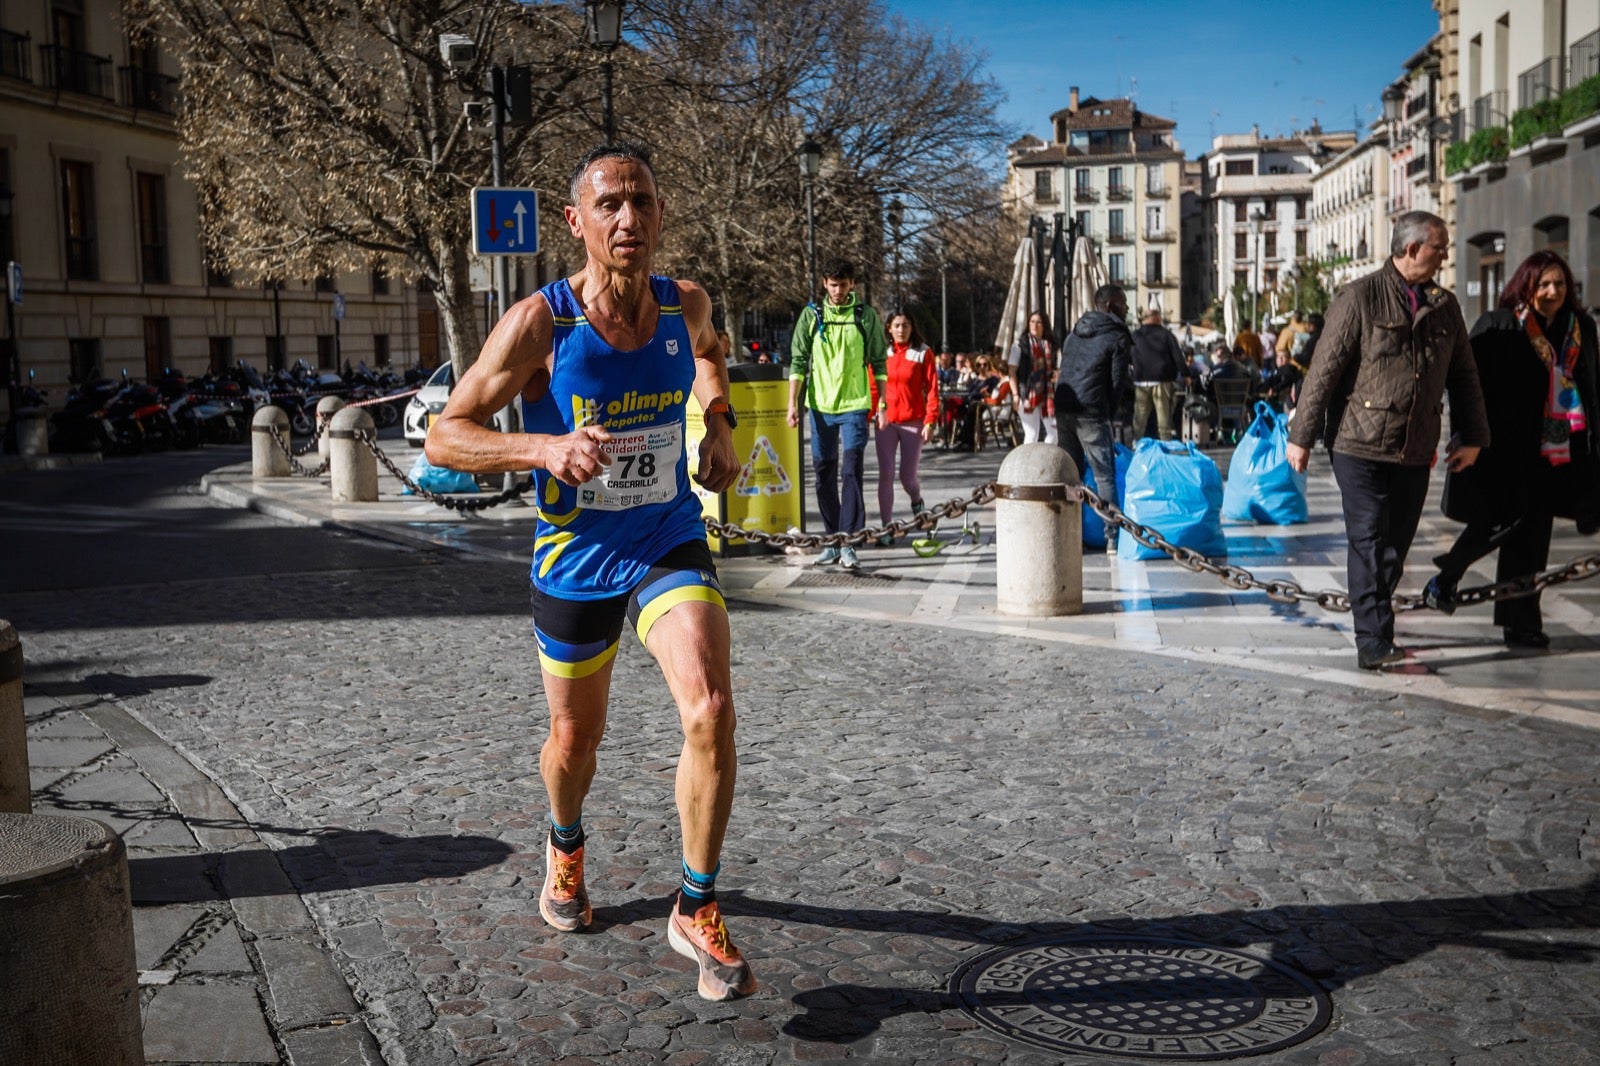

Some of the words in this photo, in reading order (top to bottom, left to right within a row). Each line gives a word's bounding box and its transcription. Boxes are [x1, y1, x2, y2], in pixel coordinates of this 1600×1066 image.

[606, 390, 683, 416] olimpo
[604, 413, 655, 429] deportes
[609, 435, 645, 445] arrera
[617, 453, 656, 479] 78
[1021, 1015, 1272, 1053] TELEFONICA
